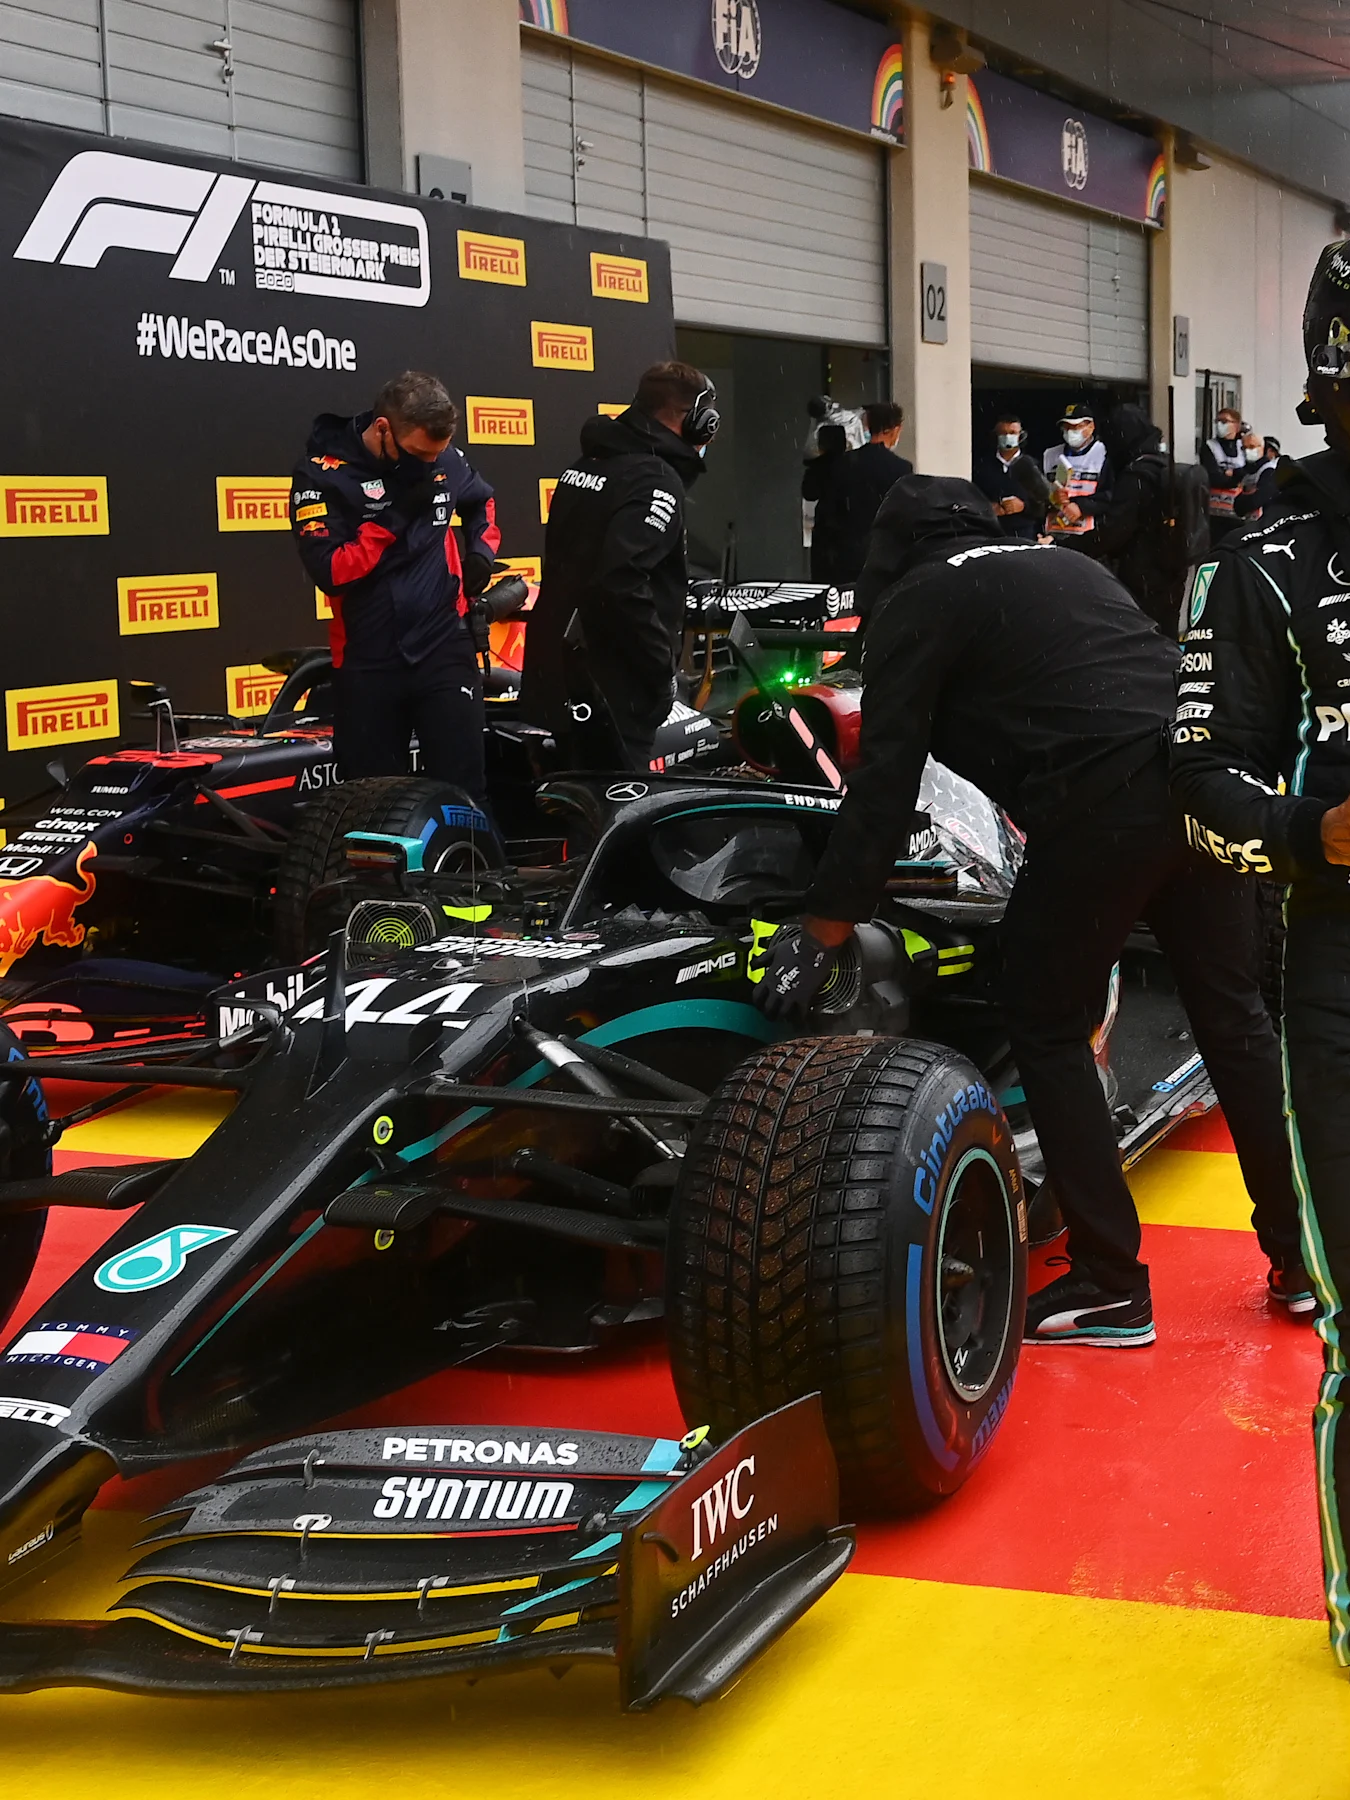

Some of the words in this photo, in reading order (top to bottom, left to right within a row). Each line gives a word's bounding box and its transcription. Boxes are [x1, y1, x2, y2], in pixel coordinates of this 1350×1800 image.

[252, 203, 329, 233] FORMULA
[331, 216, 340, 236] 1
[252, 224, 311, 251] PIRELLI
[313, 232, 379, 261] GROSSER
[381, 242, 420, 268] PREIS
[464, 240, 520, 276] PIRELLI
[219, 268, 235, 286] TM
[253, 245, 287, 270] DER
[289, 247, 386, 282] STEIERMARK
[596, 262, 643, 294] PIRELLI
[255, 269, 294, 292] 2020
[926, 282, 946, 322] 02
[136, 312, 357, 372] #WeRaceAsOne
[537, 331, 588, 362] PIRELLI
[473, 406, 528, 437] PIRELLI
[560, 469, 607, 492] TRONAS
[5, 488, 98, 524] PIRELLI
[127, 584, 209, 623] PIRELLI
[726, 588, 767, 599] MARTIN
[1180, 652, 1213, 673] PSON
[17, 692, 109, 737] PIRELLI
[90, 786, 129, 795] JUMBO
[784, 793, 816, 808] END
[2, 843, 53, 854] Mobil
[17, 832, 86, 844] PIRELLI
[1184, 813, 1274, 874] INEOS
[39, 1322, 130, 1337] TOMMY
[6, 1353, 98, 1371] HILFIGER
[382, 1437, 580, 1467] PETRONAS
[374, 1476, 575, 1520] SYNTIUM
[689, 1455, 756, 1561] IWC
[670, 1513, 779, 1618] SCHAFFHAUSEN
